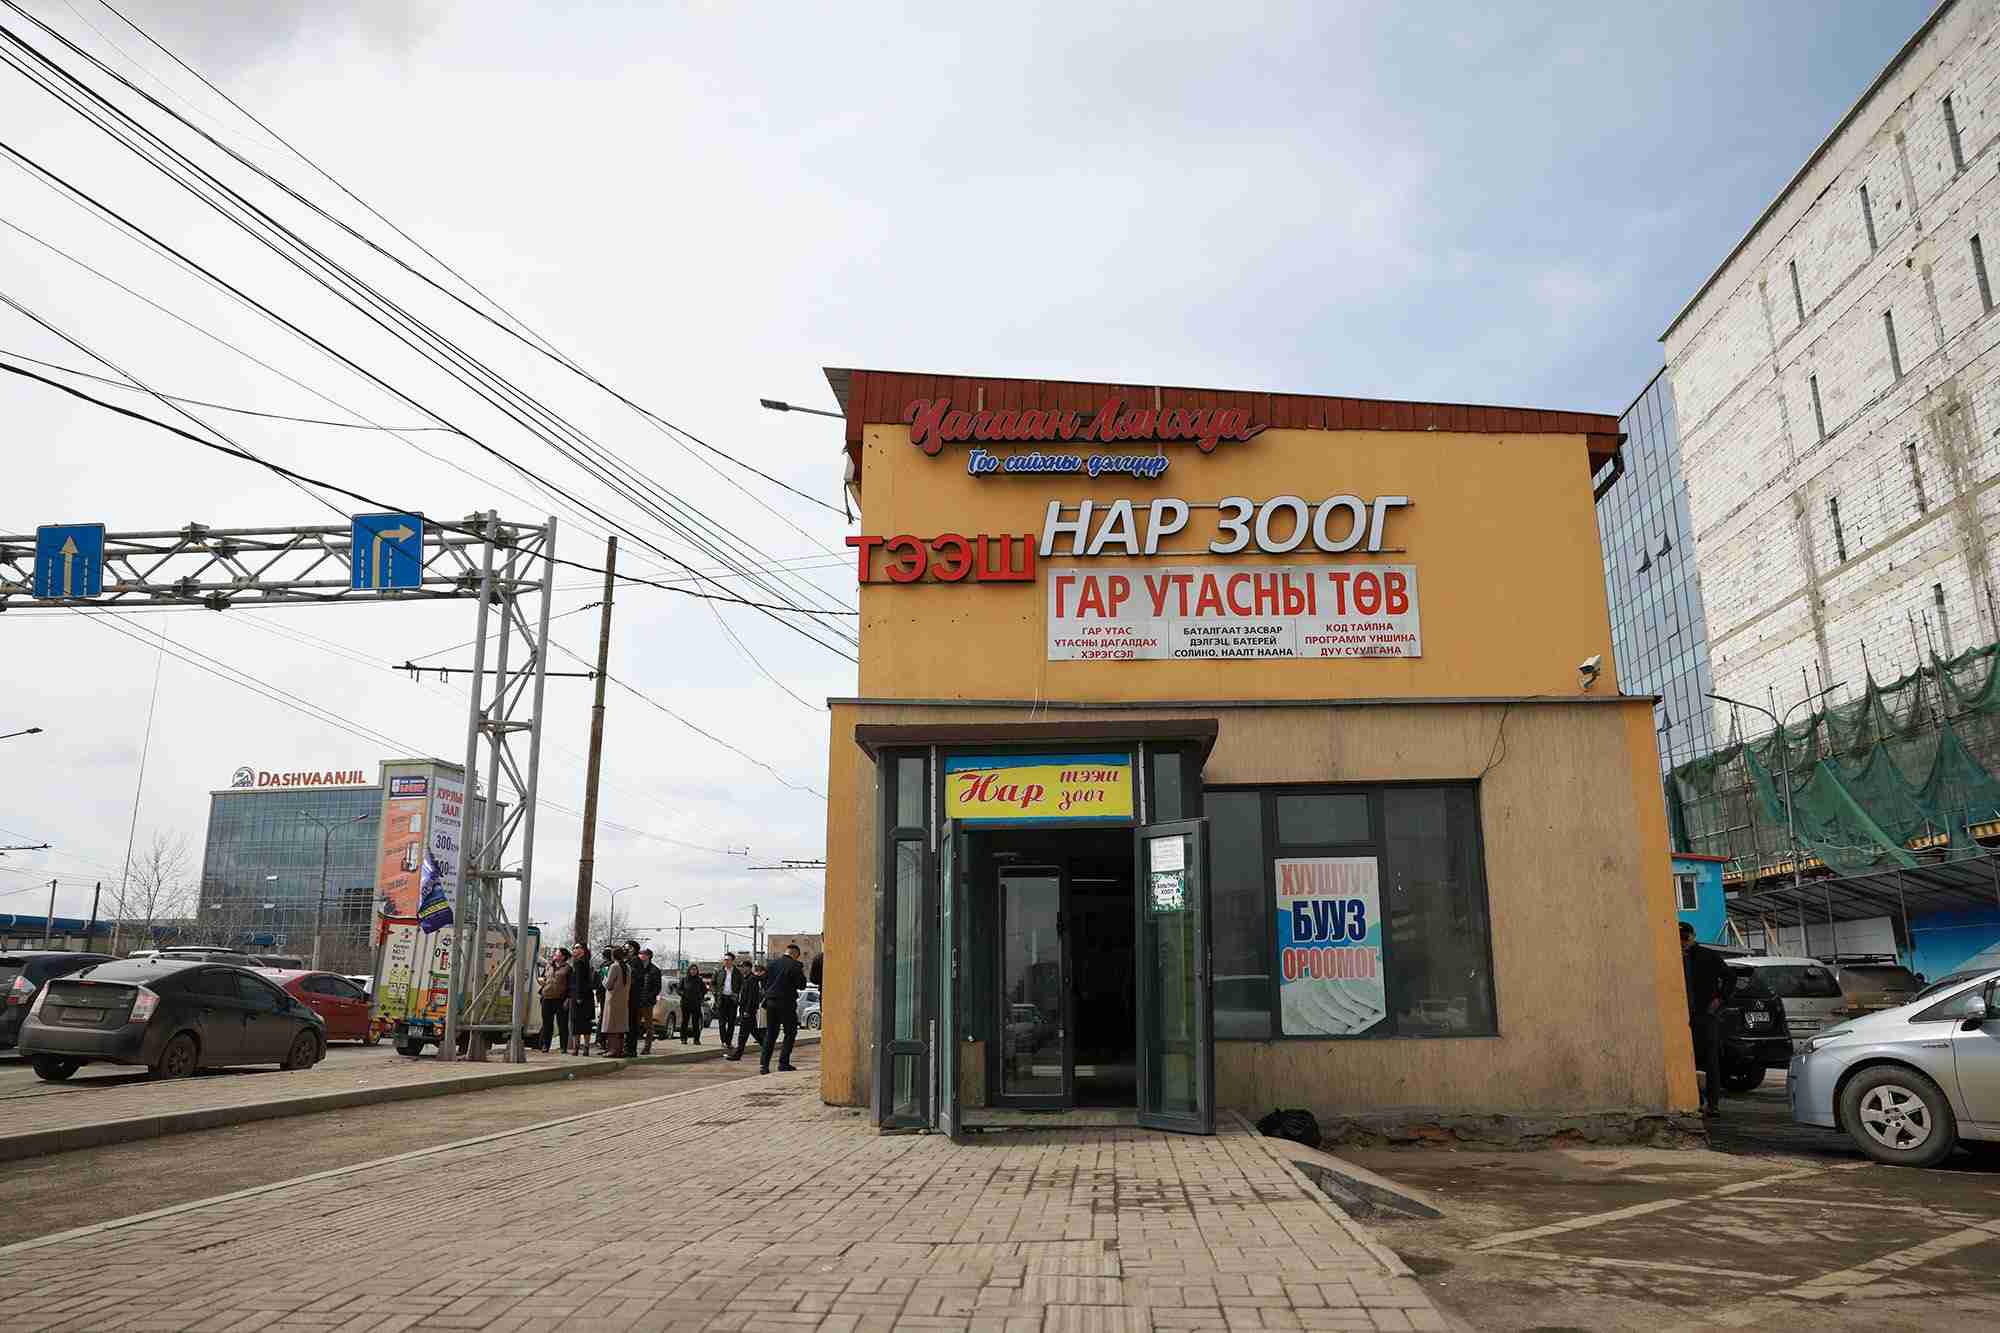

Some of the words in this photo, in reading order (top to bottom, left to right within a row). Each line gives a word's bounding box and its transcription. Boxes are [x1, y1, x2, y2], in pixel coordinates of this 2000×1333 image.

[967, 449, 999, 475] Гоо
[1002, 451, 1082, 473] сайхны
[1039, 498, 1190, 557] НАР
[1209, 495, 1409, 554] ЗООГ
[846, 534, 1037, 583] ТЭЭШ
[1055, 574, 1131, 618] ГАР
[1144, 572, 1318, 618] УТАСНЫ
[1328, 571, 1410, 615] ТӨВ
[1081, 627, 1101, 635] ГАР
[1104, 627, 1133, 635] УТАС
[1183, 626, 1241, 635] БАТАЛГААТ
[1244, 626, 1283, 635] ЗАСВАР
[1326, 623, 1347, 633] КОД
[1054, 639, 1097, 648] УТАСНЫ
[1100, 638, 1158, 649] ДАГАЛДАХ
[1233, 636, 1277, 645] БАТЕРЕЙ
[1304, 635, 1366, 645] ПРОГРАММ
[1081, 650, 1134, 659] ХЭРЭГСЭЛ
[1221, 648, 1254, 657] НААЛТ
[1257, 647, 1293, 656] НААНА
[1320, 647, 1342, 657] ДУУ
[1345, 646, 1402, 656] СУУЛГАНА
[257, 770, 366, 787] DASHVAANJIL
[958, 773, 1045, 809] Нар
[1058, 788, 1105, 810] зоог
[435, 834, 452, 851] 300
[1292, 898, 1367, 942] БУУЗ
[1282, 947, 1377, 981] ОРООМОГ
